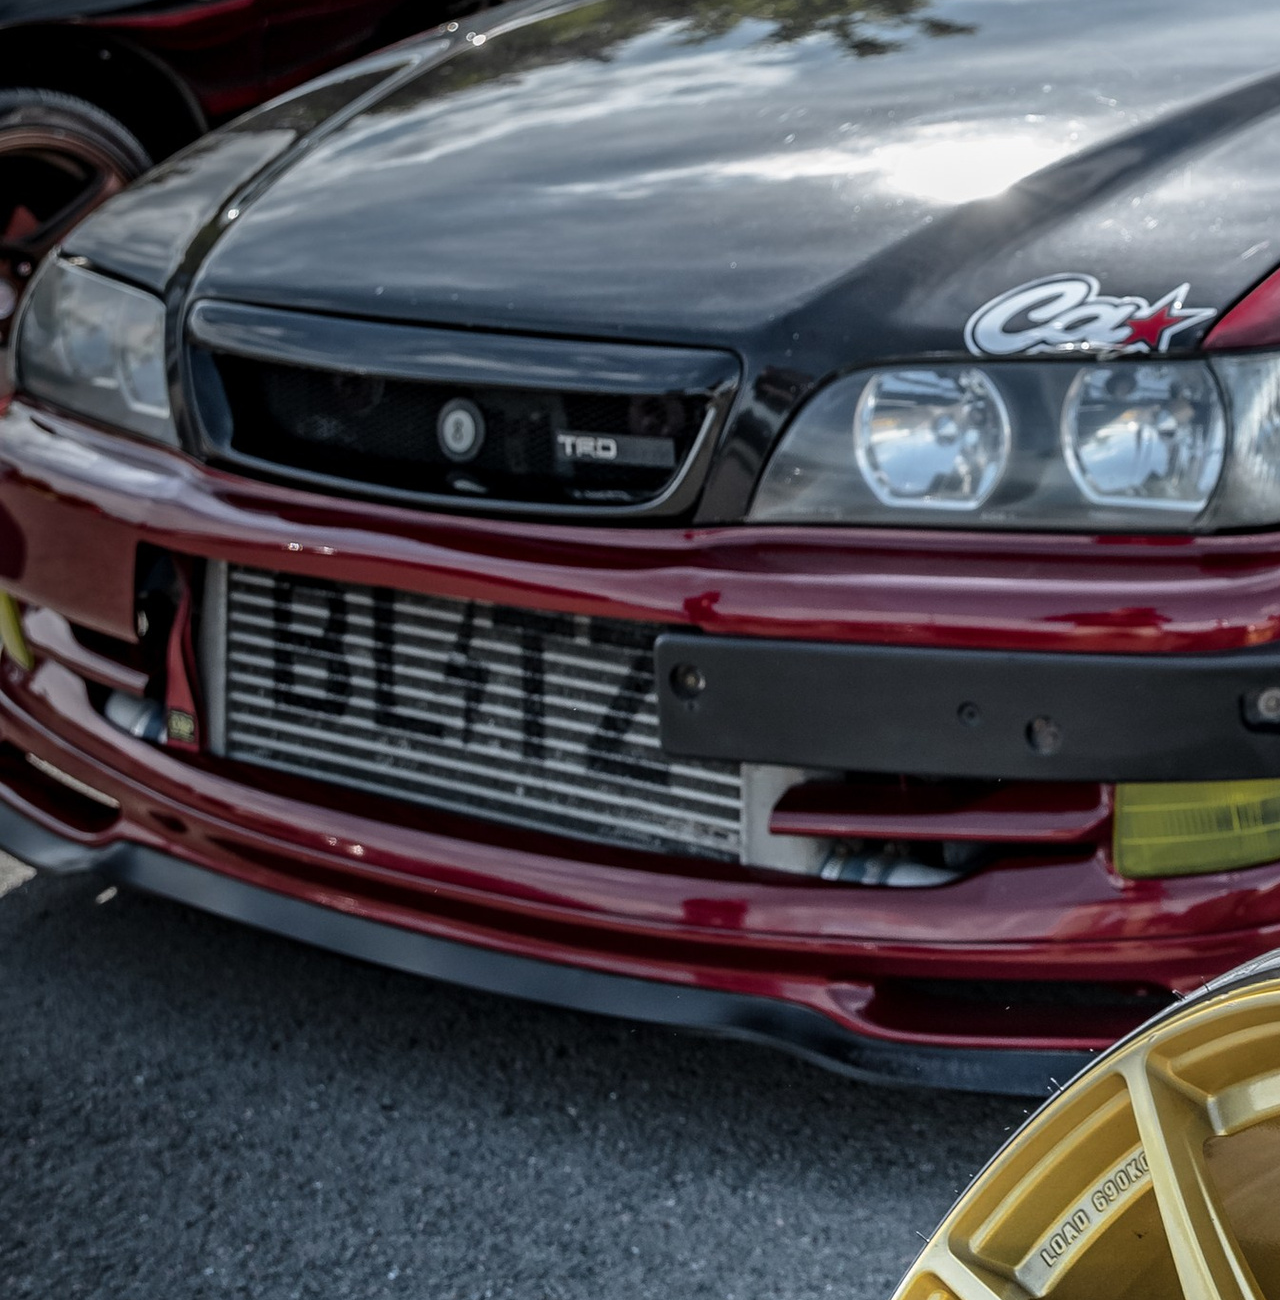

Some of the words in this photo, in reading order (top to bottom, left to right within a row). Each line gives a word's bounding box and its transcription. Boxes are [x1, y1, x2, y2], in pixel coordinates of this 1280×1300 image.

[557, 433, 618, 460] TRD
[272, 573, 671, 788] BLITZ
[1040, 1209, 1091, 1268] LOAD
